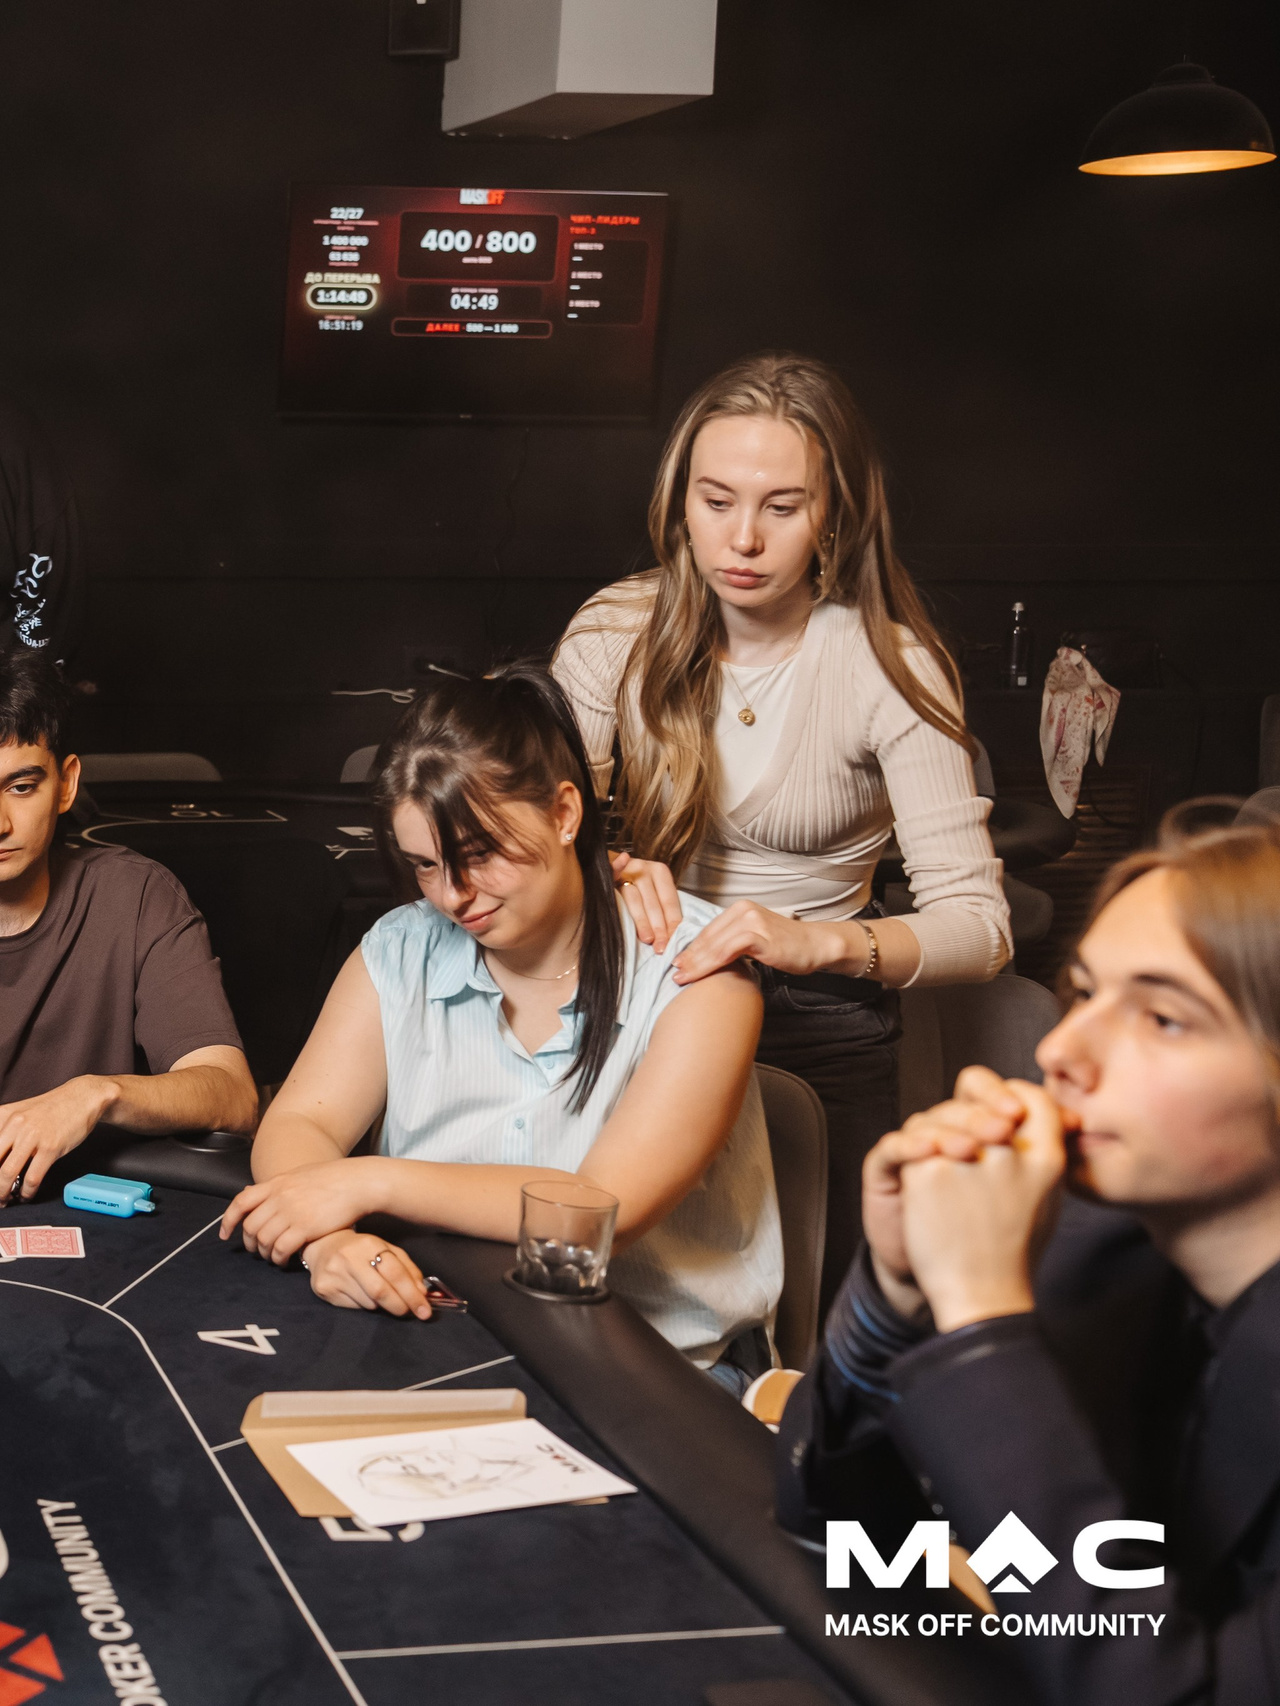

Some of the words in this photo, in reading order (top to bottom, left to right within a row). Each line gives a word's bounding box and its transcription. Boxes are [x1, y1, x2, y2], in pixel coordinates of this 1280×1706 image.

[330, 207, 364, 220] 22/27
[420, 229, 472, 252] 400
[485, 230, 537, 253] 800
[316, 289, 368, 304] 1:14:49
[450, 293, 499, 310] 04:49
[197, 1324, 280, 1355] 4
[36, 1498, 134, 1642] COMMUNITY
[98, 1643, 168, 1706] OKER
